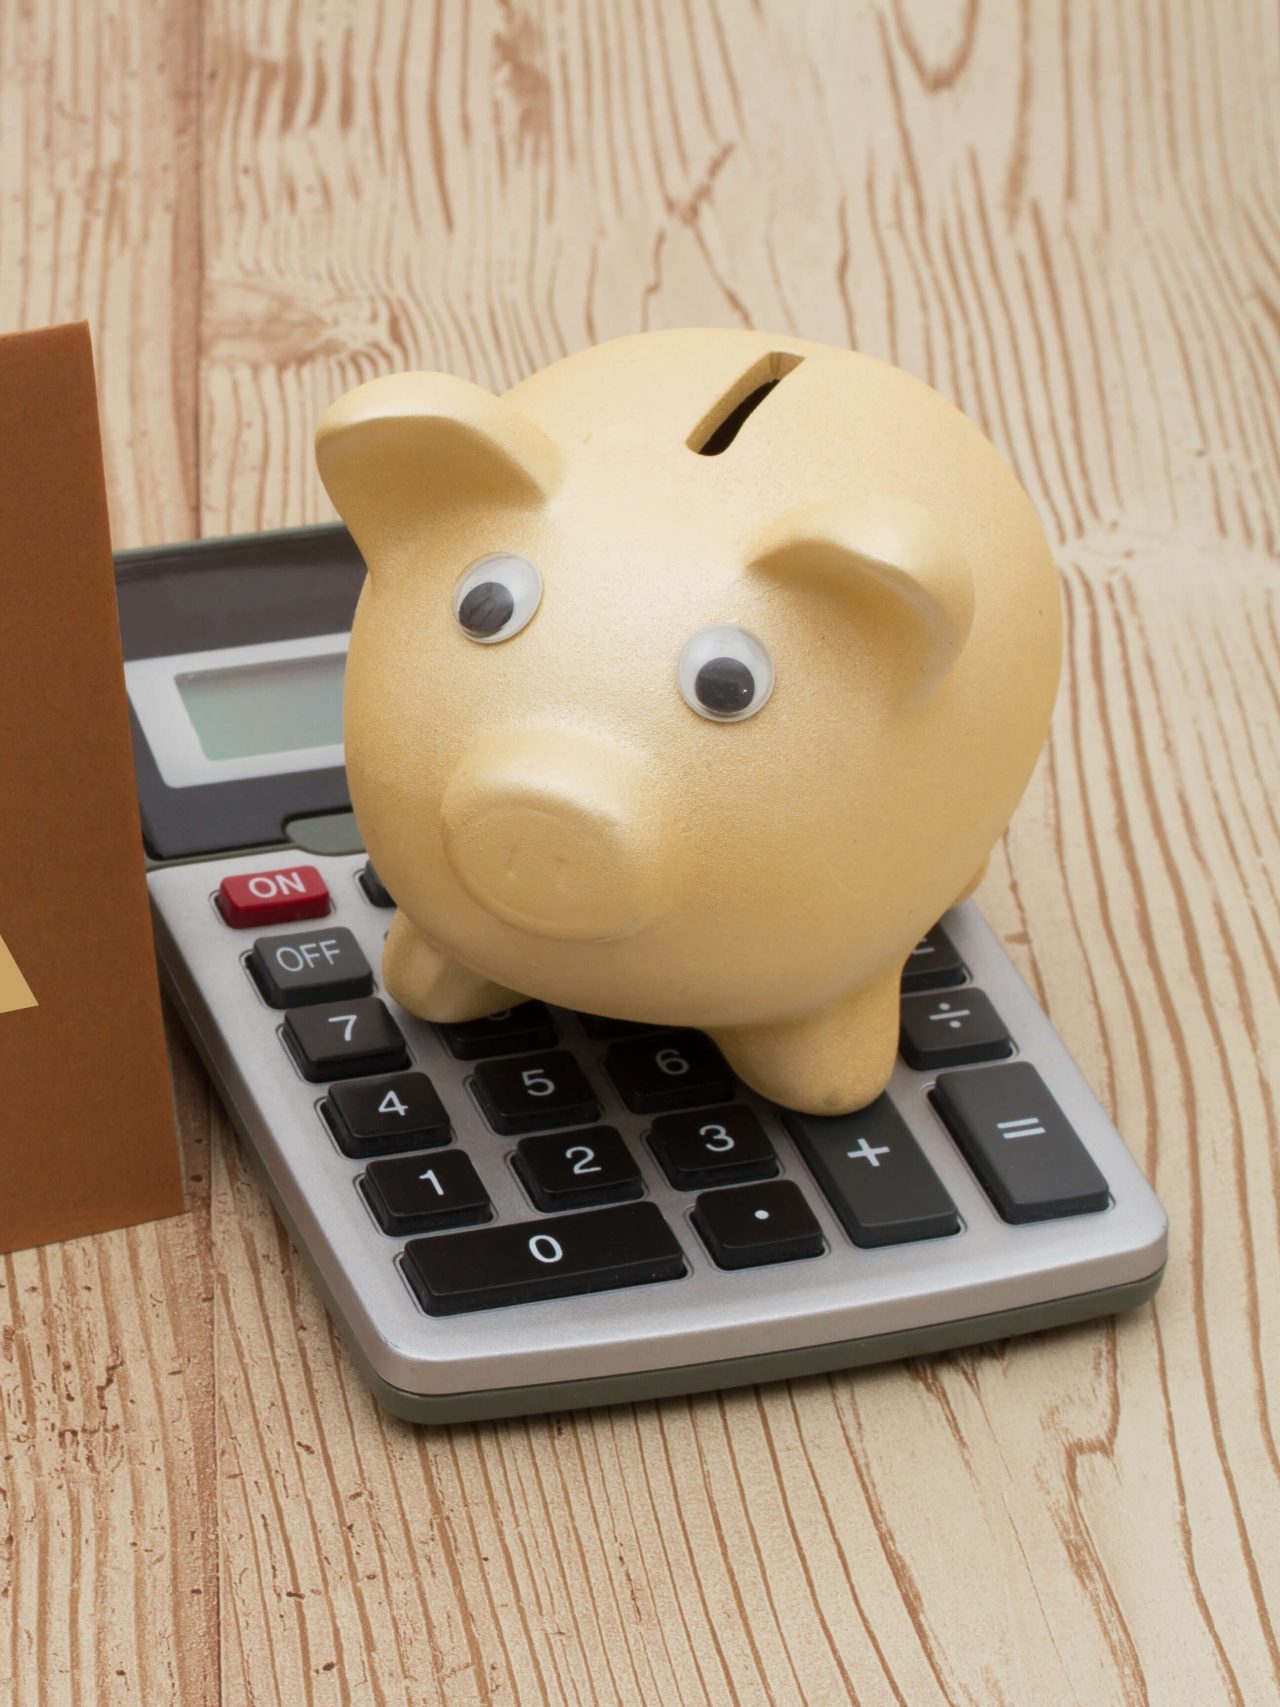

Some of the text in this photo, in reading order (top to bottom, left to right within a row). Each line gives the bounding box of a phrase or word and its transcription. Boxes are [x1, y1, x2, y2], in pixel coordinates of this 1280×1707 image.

[248, 871, 307, 899] ON
[275, 939, 341, 972] OFF
[328, 1014, 358, 1042] 7
[655, 1049, 690, 1076] 6
[521, 1069, 555, 1097] 5
[378, 1090, 408, 1116] 4
[700, 1125, 735, 1152] 3
[565, 1146, 602, 1175] 2
[419, 1169, 444, 1196] 1
[528, 1234, 563, 1263] 0
